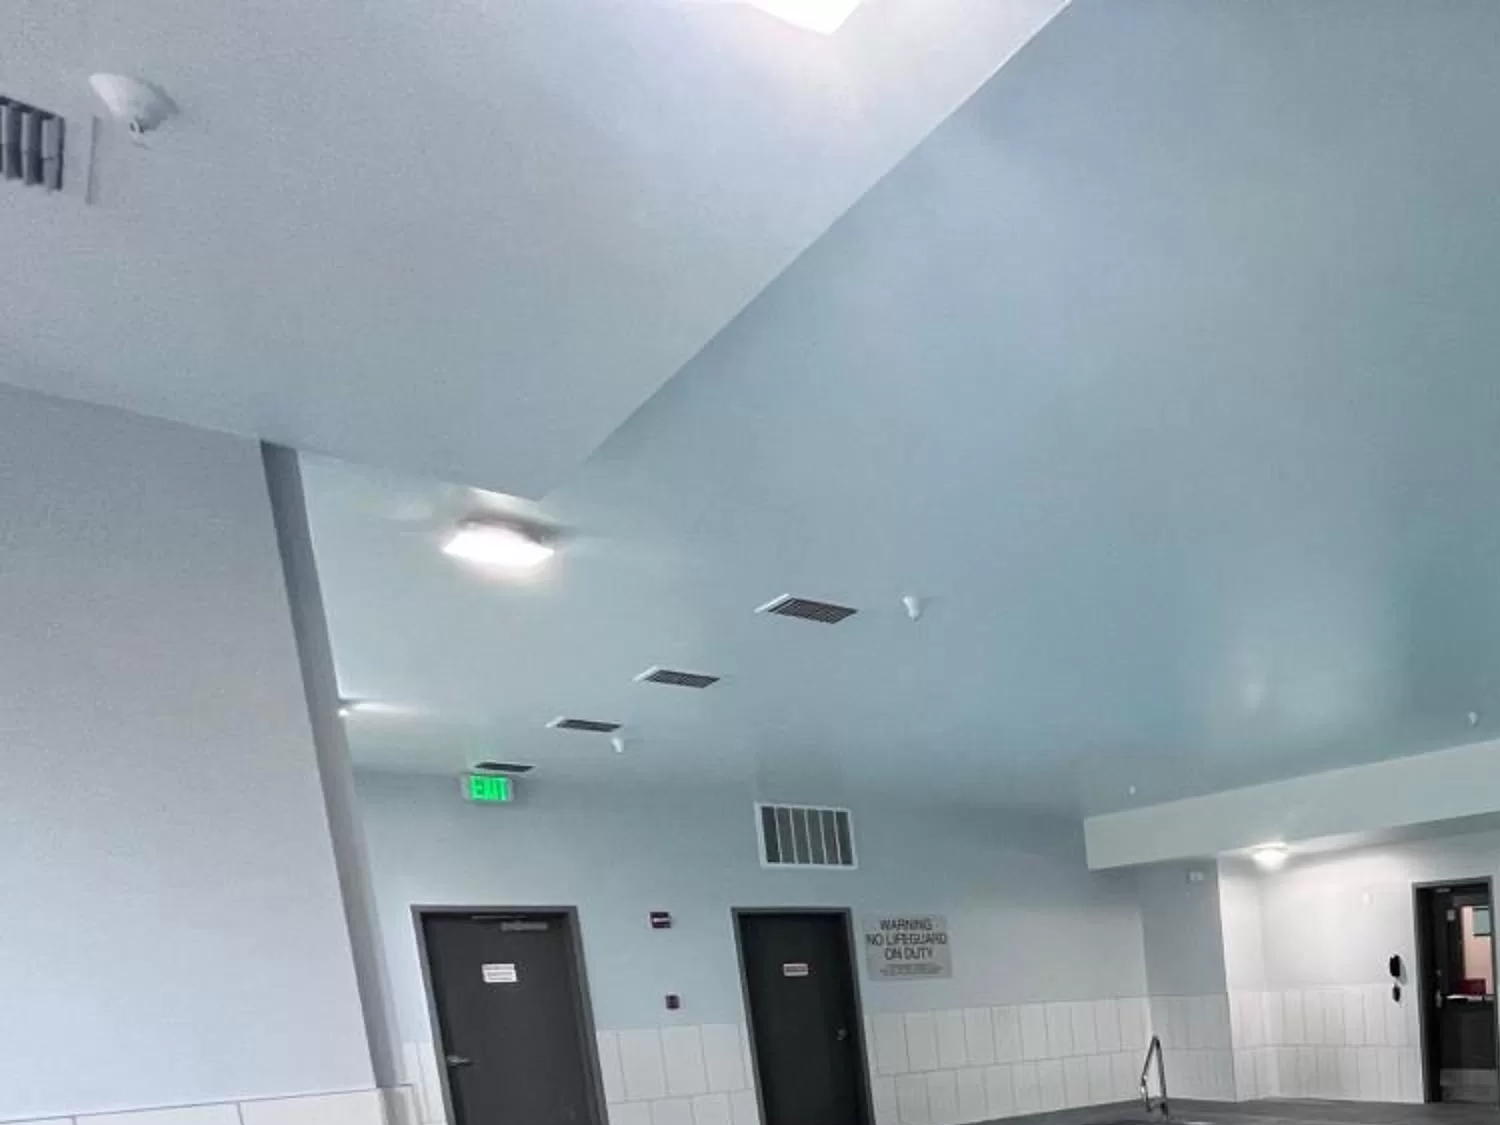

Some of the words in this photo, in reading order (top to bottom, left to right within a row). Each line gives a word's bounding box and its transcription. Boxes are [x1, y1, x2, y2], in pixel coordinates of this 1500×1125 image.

[881, 918, 932, 931] WARNING
[866, 933, 884, 946] NO
[886, 932, 947, 946] LIFEGUARD
[885, 948, 902, 960] ON
[904, 947, 933, 960] DUTY
